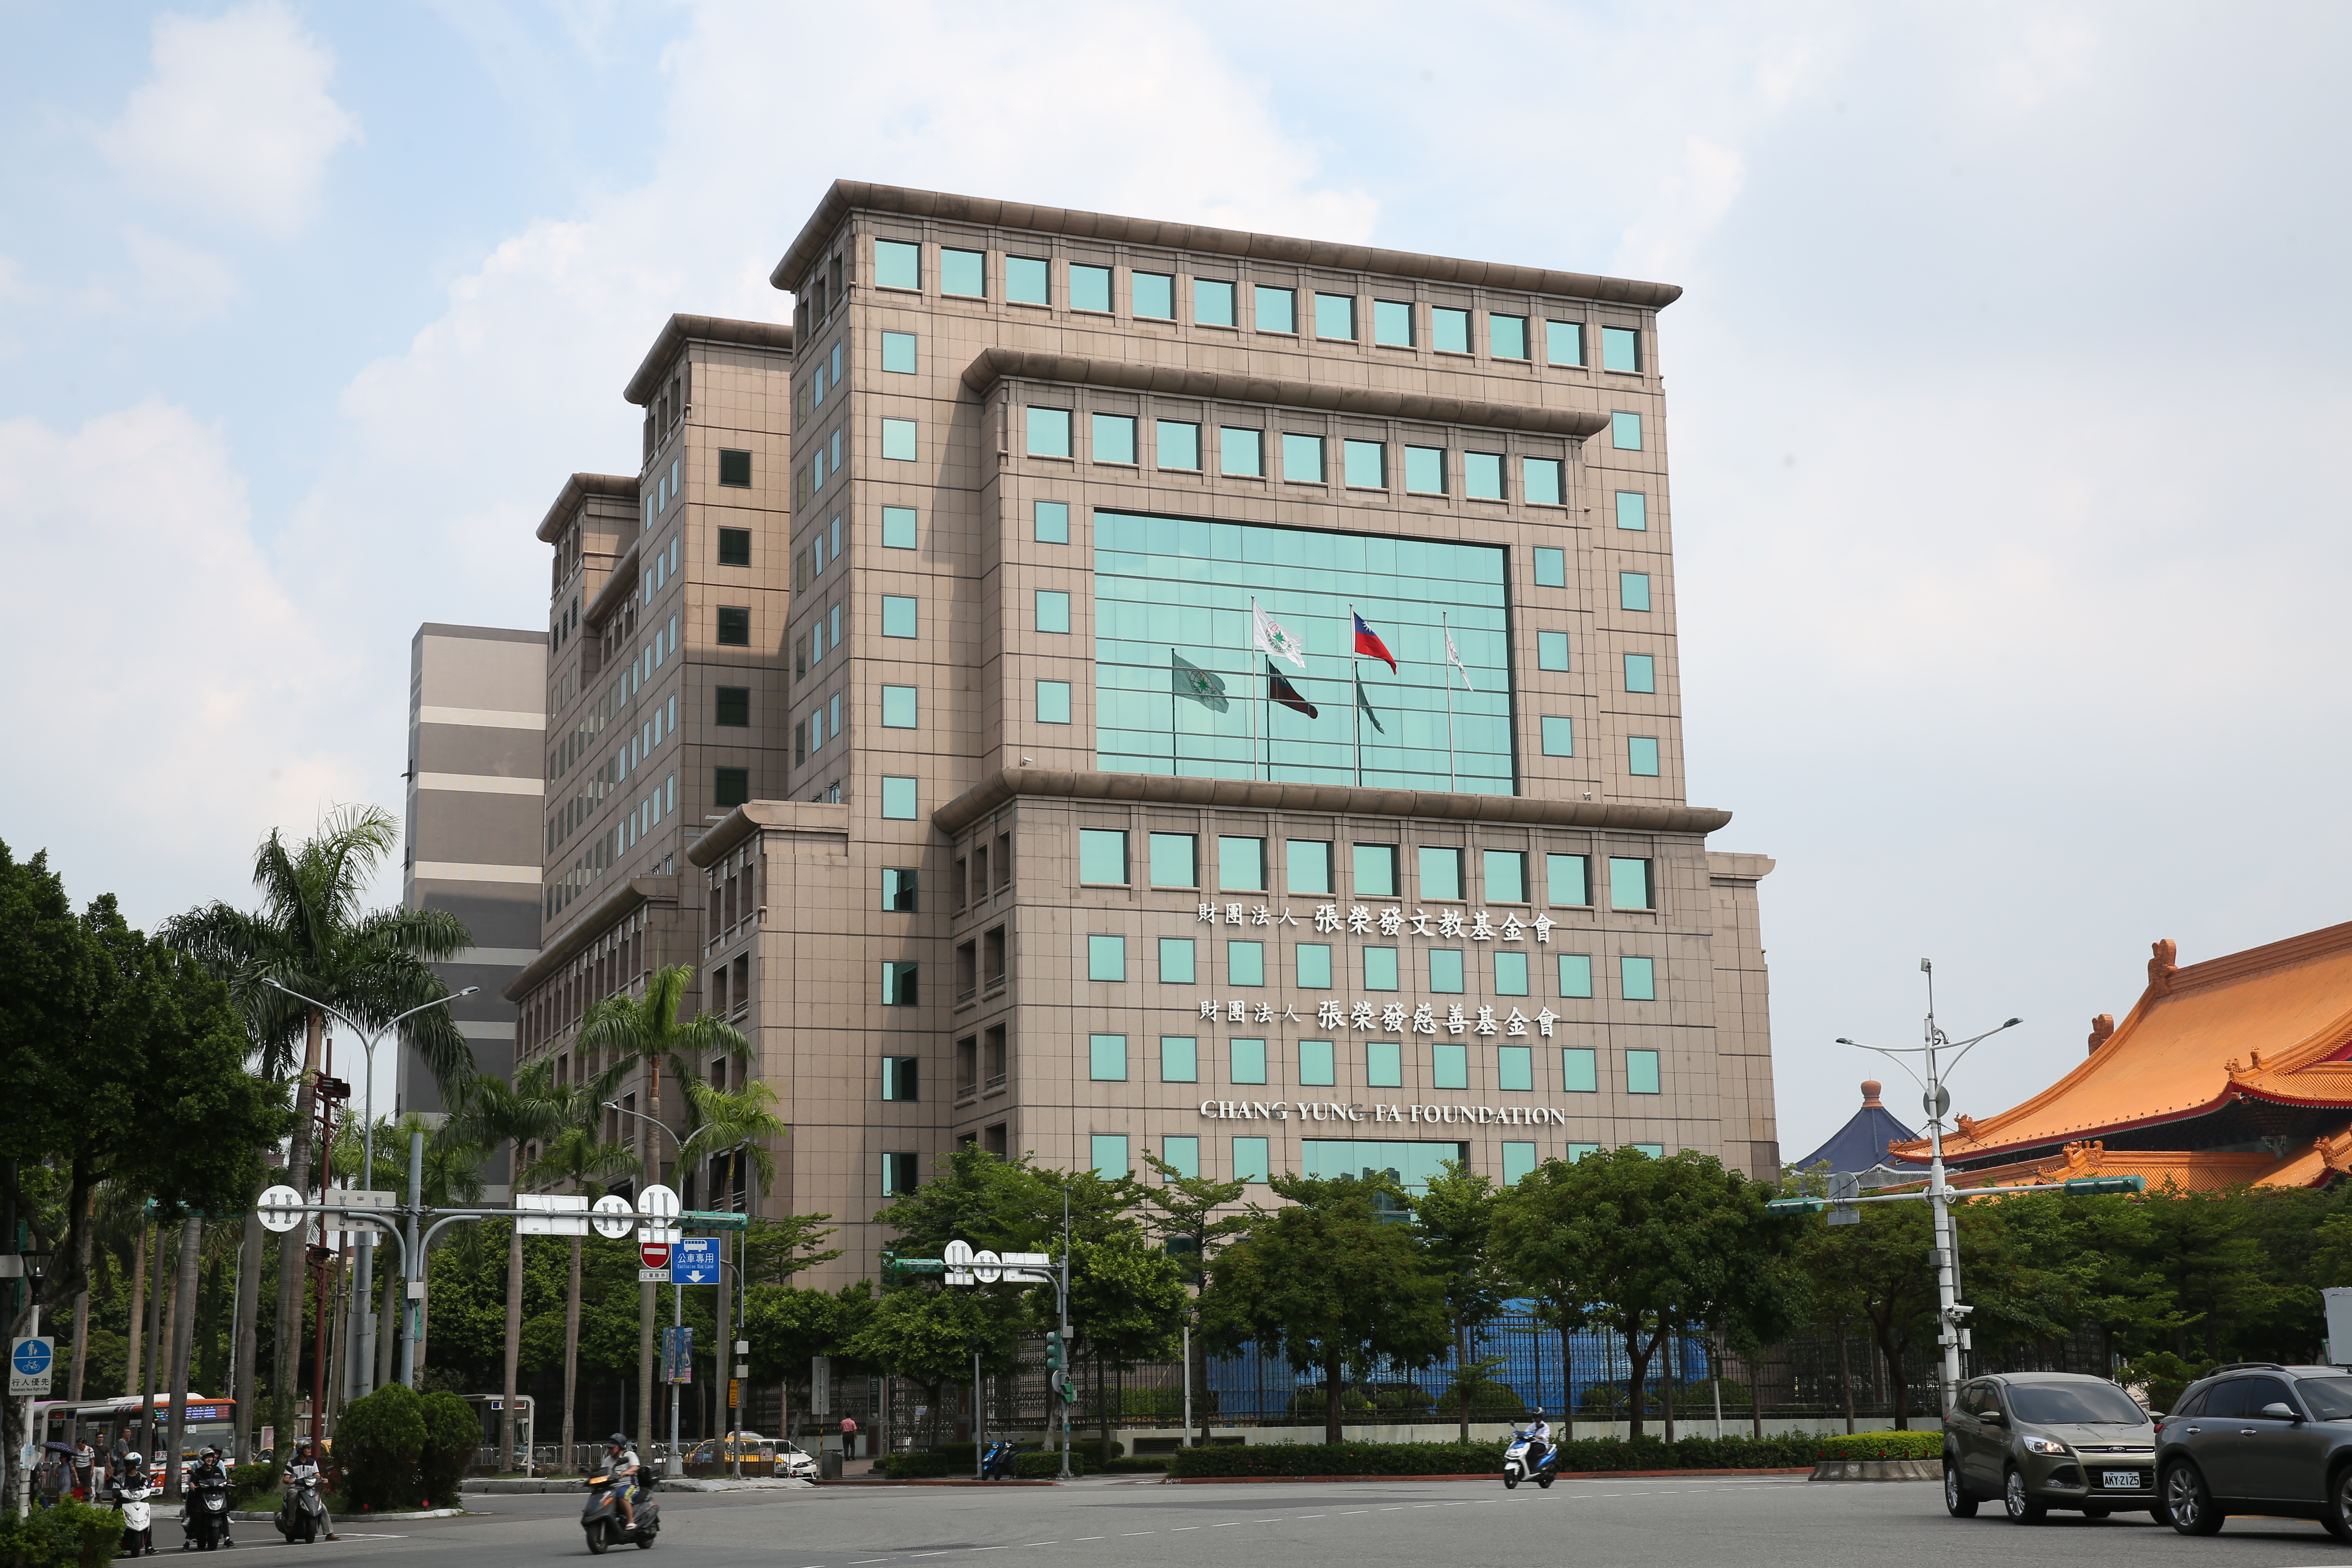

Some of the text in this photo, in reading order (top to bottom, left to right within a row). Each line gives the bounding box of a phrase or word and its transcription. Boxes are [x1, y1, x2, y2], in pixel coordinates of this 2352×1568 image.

[1196, 902, 1558, 943] 財團法人 張榮發文教基金會
[1199, 999, 1561, 1037] 財團法人 張榮發慈善基金會
[1200, 1100, 1289, 1120] CHANG
[1410, 1104, 1566, 1126] FOUNDATION
[677, 1253, 714, 1263] 公車專用
[12, 1378, 49, 1386] 行人優先
[2105, 1476, 2139, 1485] AKY-2125
